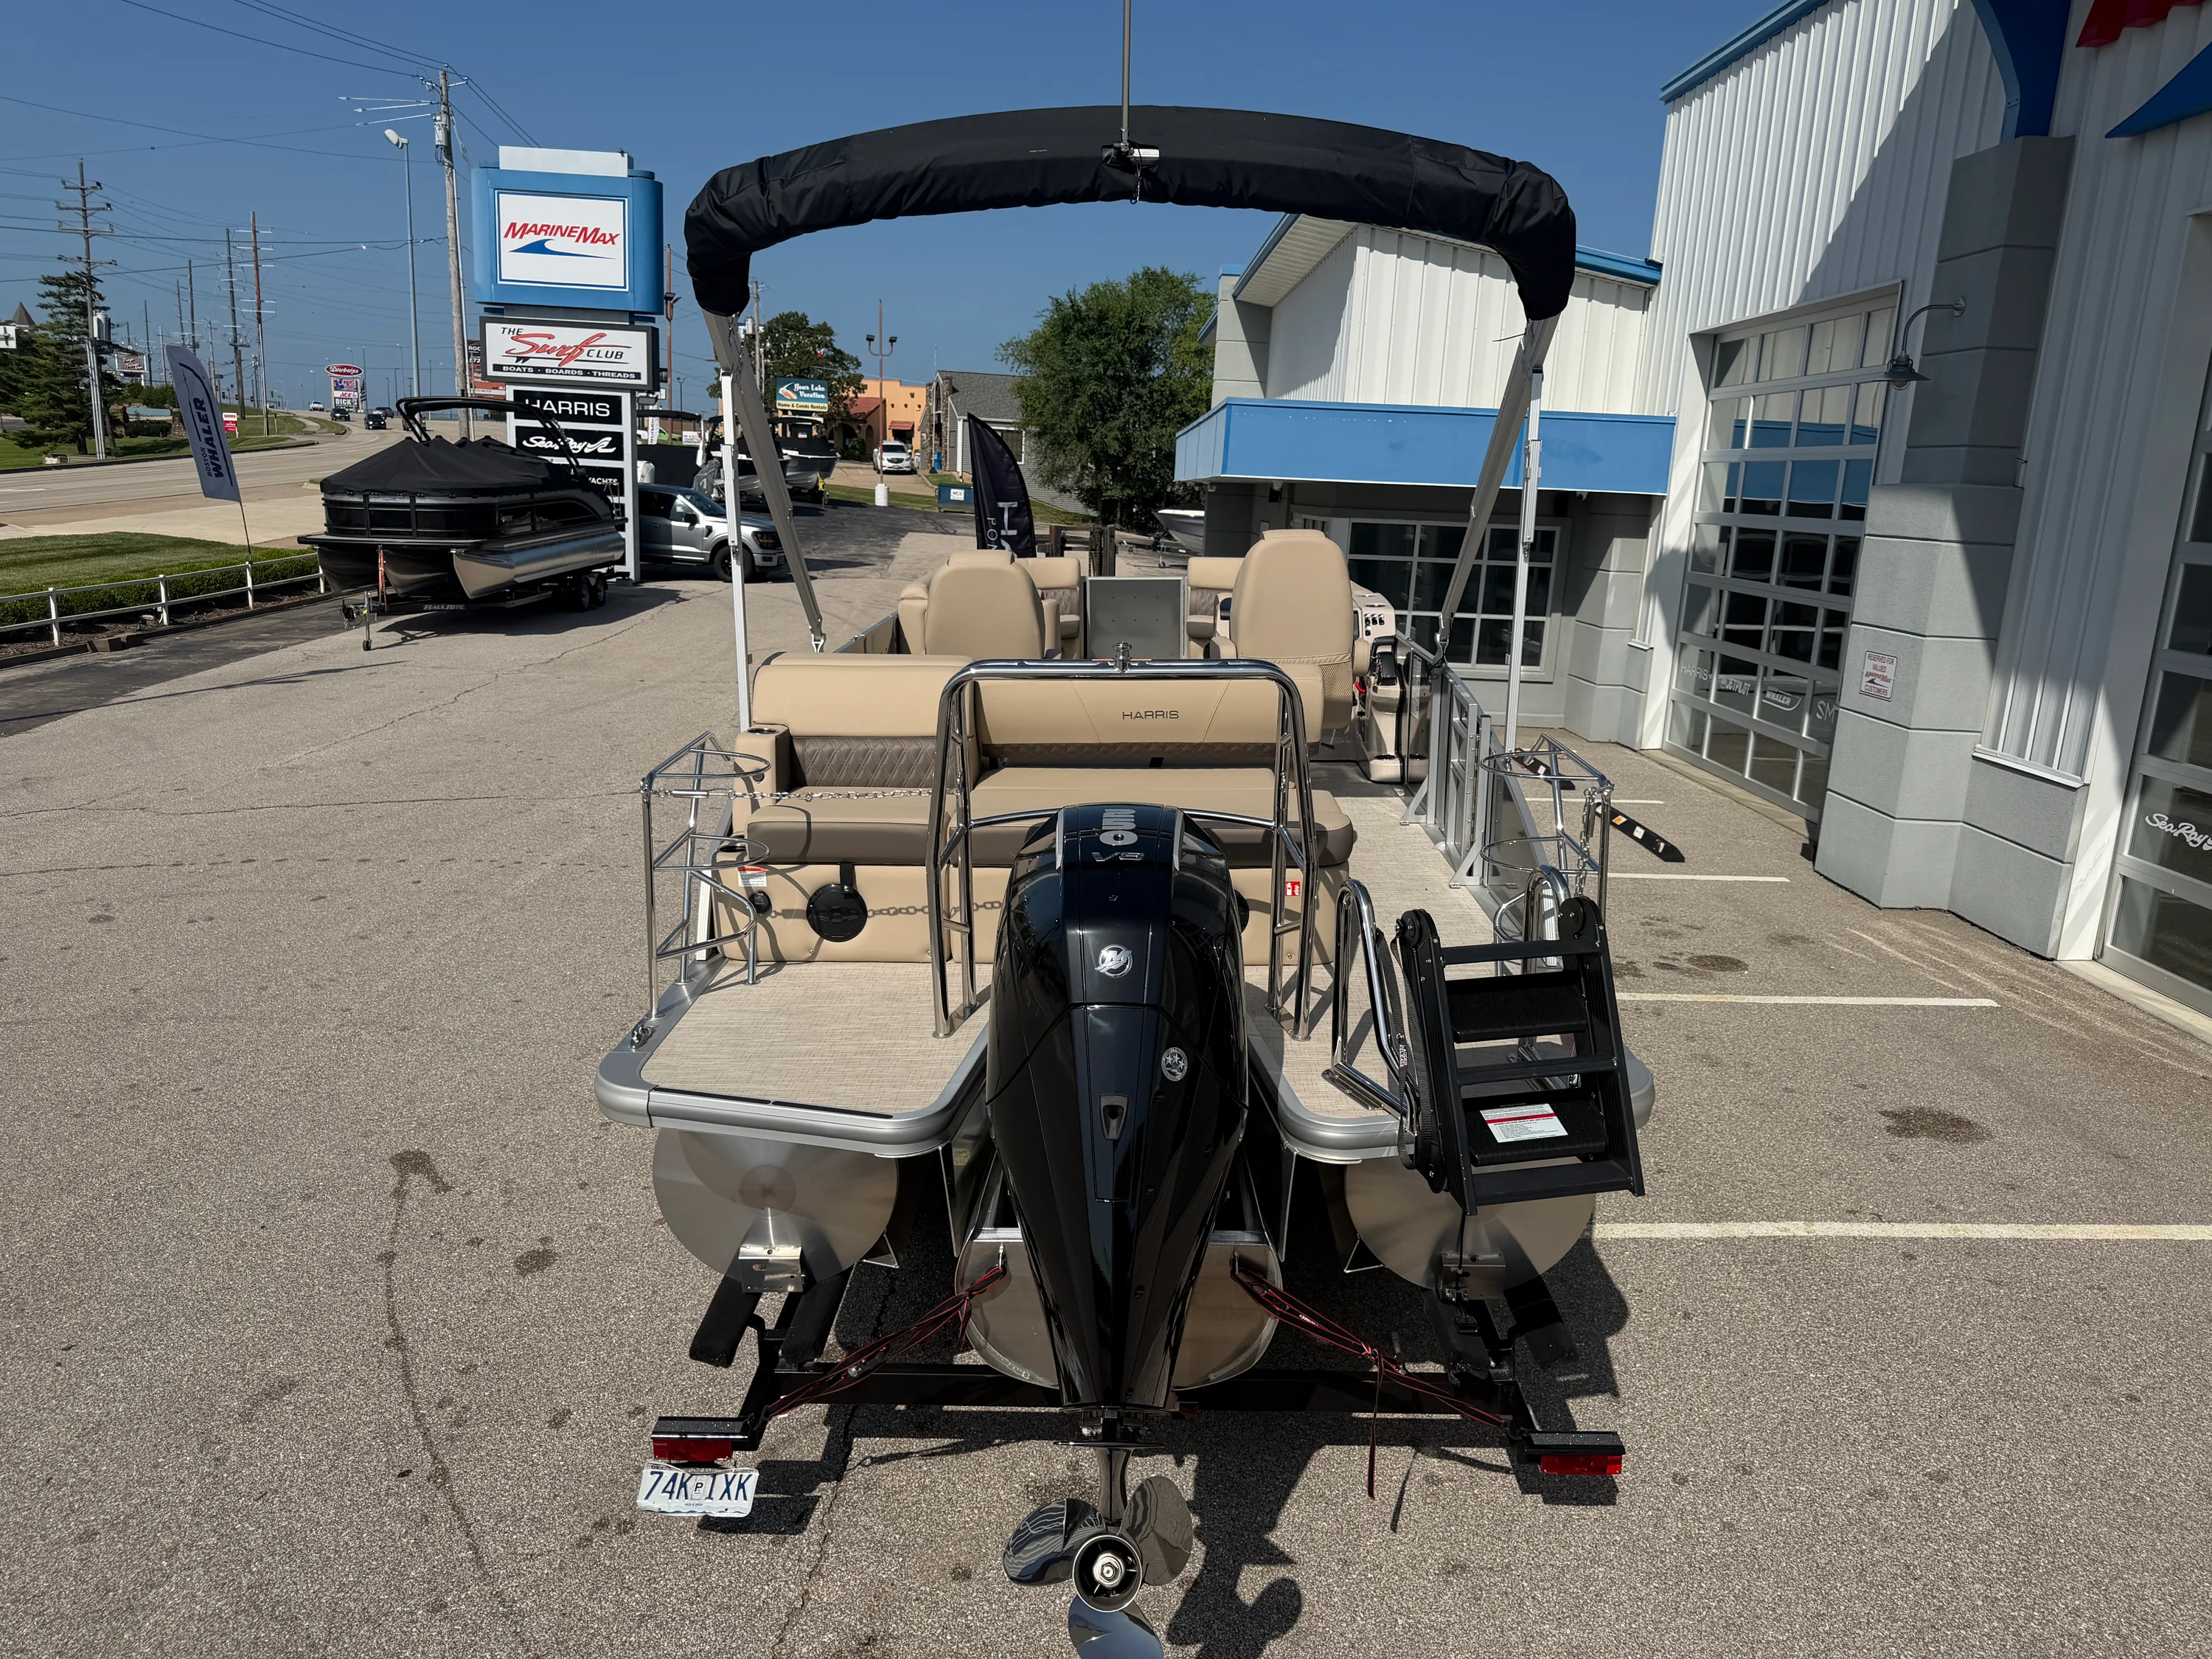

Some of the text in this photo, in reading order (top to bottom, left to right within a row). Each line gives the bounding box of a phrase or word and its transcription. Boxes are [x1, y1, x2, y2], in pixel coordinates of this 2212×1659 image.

[501, 327, 524, 335] THE
[505, 333, 633, 367] Surf
[586, 349, 625, 360] CLUB
[545, 368, 584, 376] BOARDS
[592, 371, 636, 379] THREADS
[793, 383, 826, 392] Your Lake
[799, 391, 826, 399] Vacation
[193, 397, 224, 478] WHALER
[200, 447, 212, 477] BOSTON
[1868, 653, 1895, 666] RESERVED FOR
[1681, 663, 1709, 681] HARRIS
[1873, 664, 1887, 673] VALUED
[1865, 684, 1888, 696] CUSTOMERS
[1765, 690, 1792, 706] WHALER
[1122, 710, 1179, 720] HARRIS
